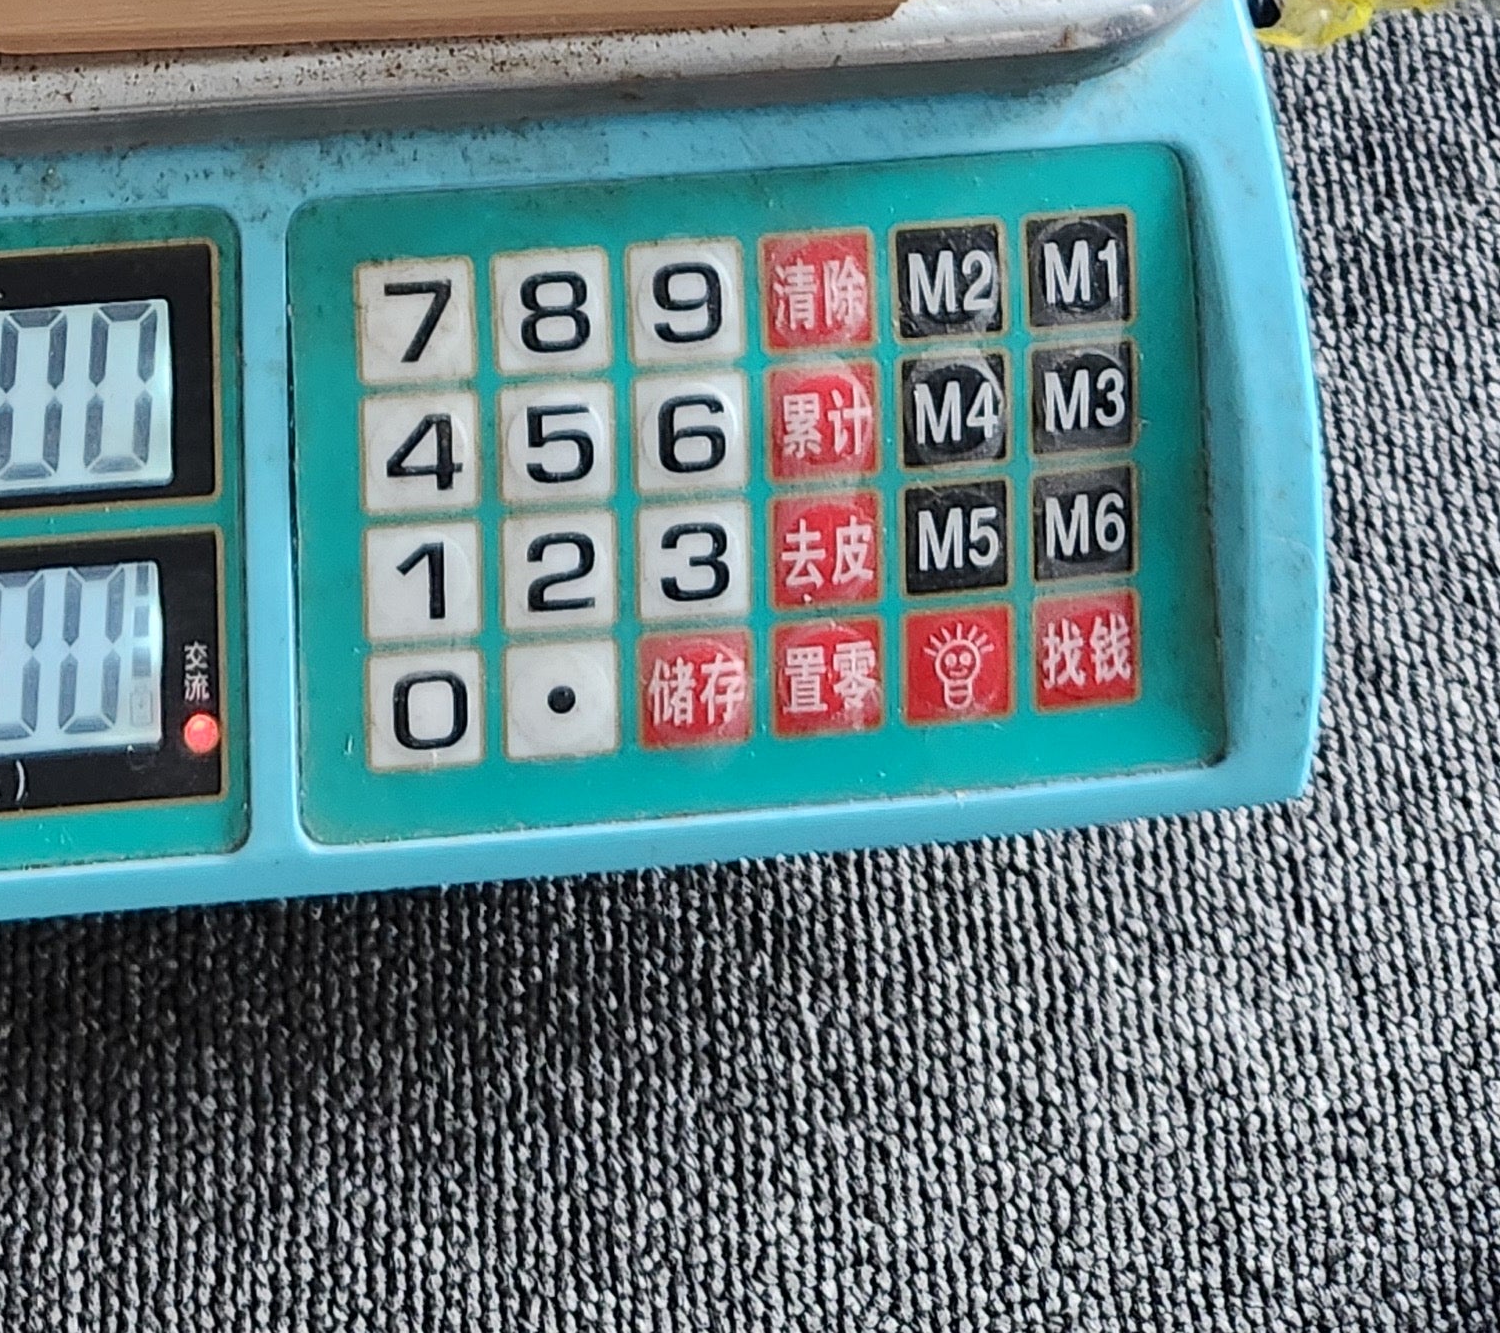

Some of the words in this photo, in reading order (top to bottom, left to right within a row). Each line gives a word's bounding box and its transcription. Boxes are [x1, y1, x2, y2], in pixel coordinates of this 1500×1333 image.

[652, 262, 724, 343] 9
[773, 256, 867, 331] 清除
[908, 250, 995, 315] M2
[1043, 238, 1120, 305] M1
[384, 278, 453, 364] 7
[520, 270, 591, 354] 8
[657, 394, 728, 474] 6
[782, 388, 872, 459] 累计
[914, 380, 1001, 446] M4
[1044, 367, 1126, 434] M3
[386, 413, 463, 491] 4
[526, 404, 595, 484] 5
[660, 522, 731, 602] 3
[781, 514, 875, 592] 去皮
[918, 506, 999, 572] M5
[1044, 492, 1126, 559] M6
[396, 541, 446, 621] 1
[526, 532, 596, 613] 2
[184, 642, 211, 703] 交流
[783, 640, 878, 717] 置零
[1043, 614, 1132, 690] 找钱
[392, 669, 469, 751] 0
[648, 656, 746, 727] 储存
